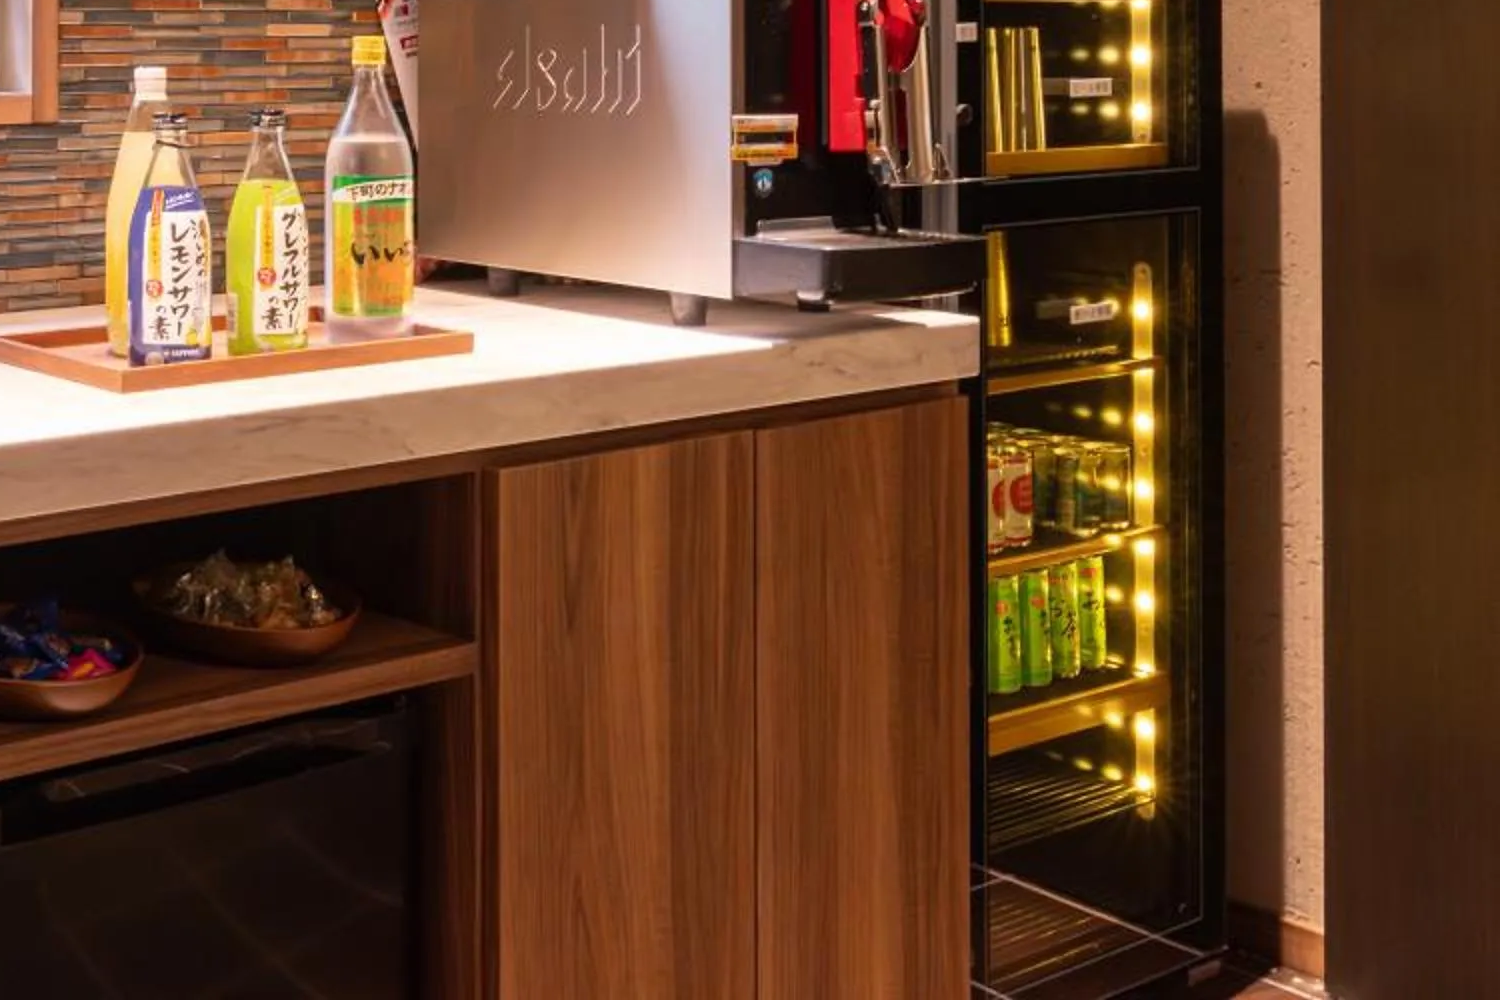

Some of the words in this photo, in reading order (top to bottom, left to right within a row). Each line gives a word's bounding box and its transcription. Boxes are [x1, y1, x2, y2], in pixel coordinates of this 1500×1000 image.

[167, 222, 193, 337] レモンサワー
[280, 208, 302, 330] グレフルサワー
[148, 304, 172, 341] の素
[261, 295, 283, 331] の素
